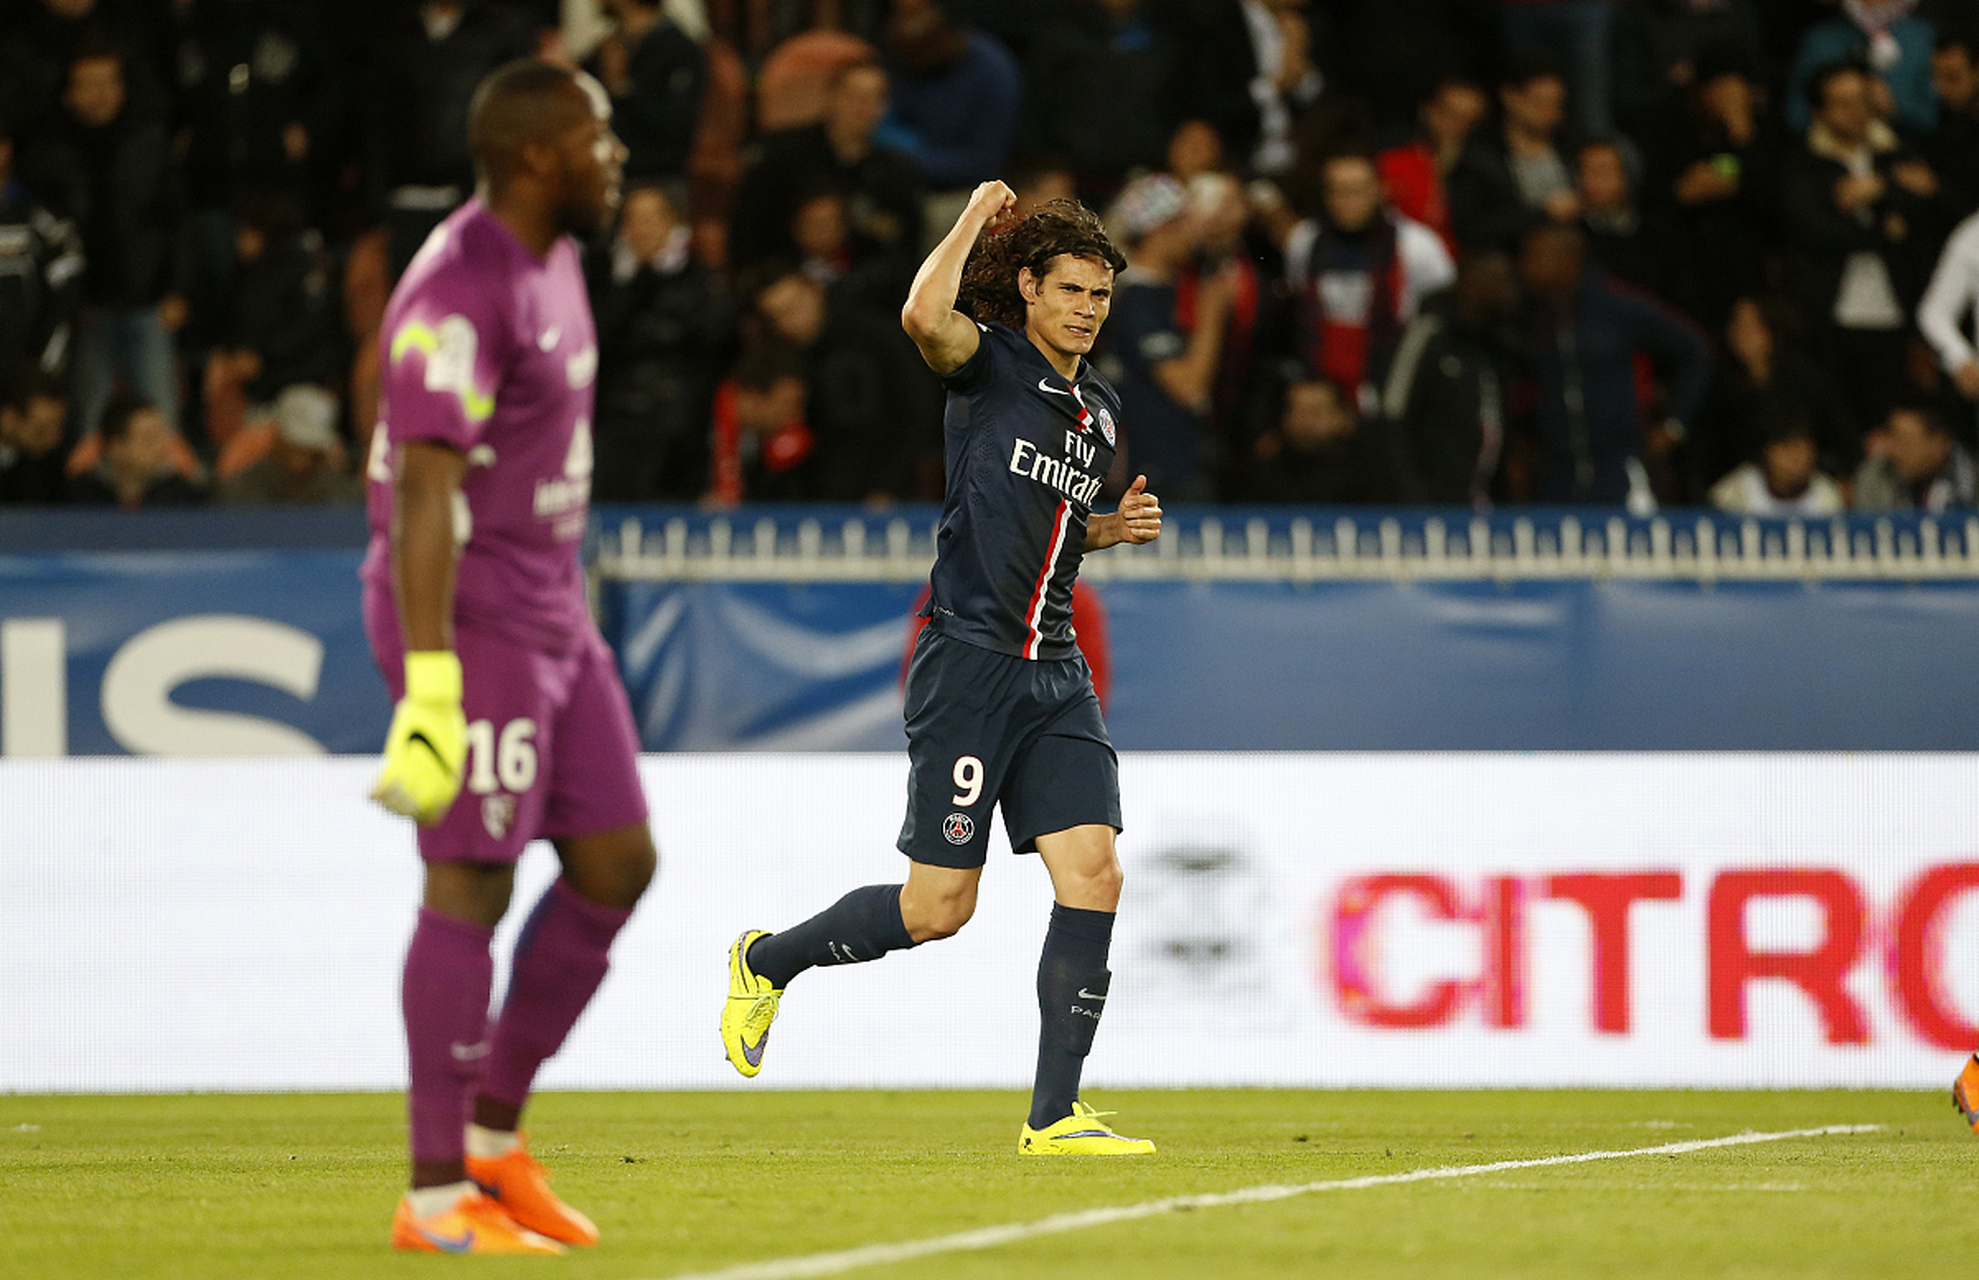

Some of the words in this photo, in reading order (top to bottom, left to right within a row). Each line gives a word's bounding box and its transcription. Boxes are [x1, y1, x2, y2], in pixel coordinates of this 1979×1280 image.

[1065, 430, 1096, 468] Fly
[467, 716, 538, 794] 16
[952, 755, 985, 806] 9
